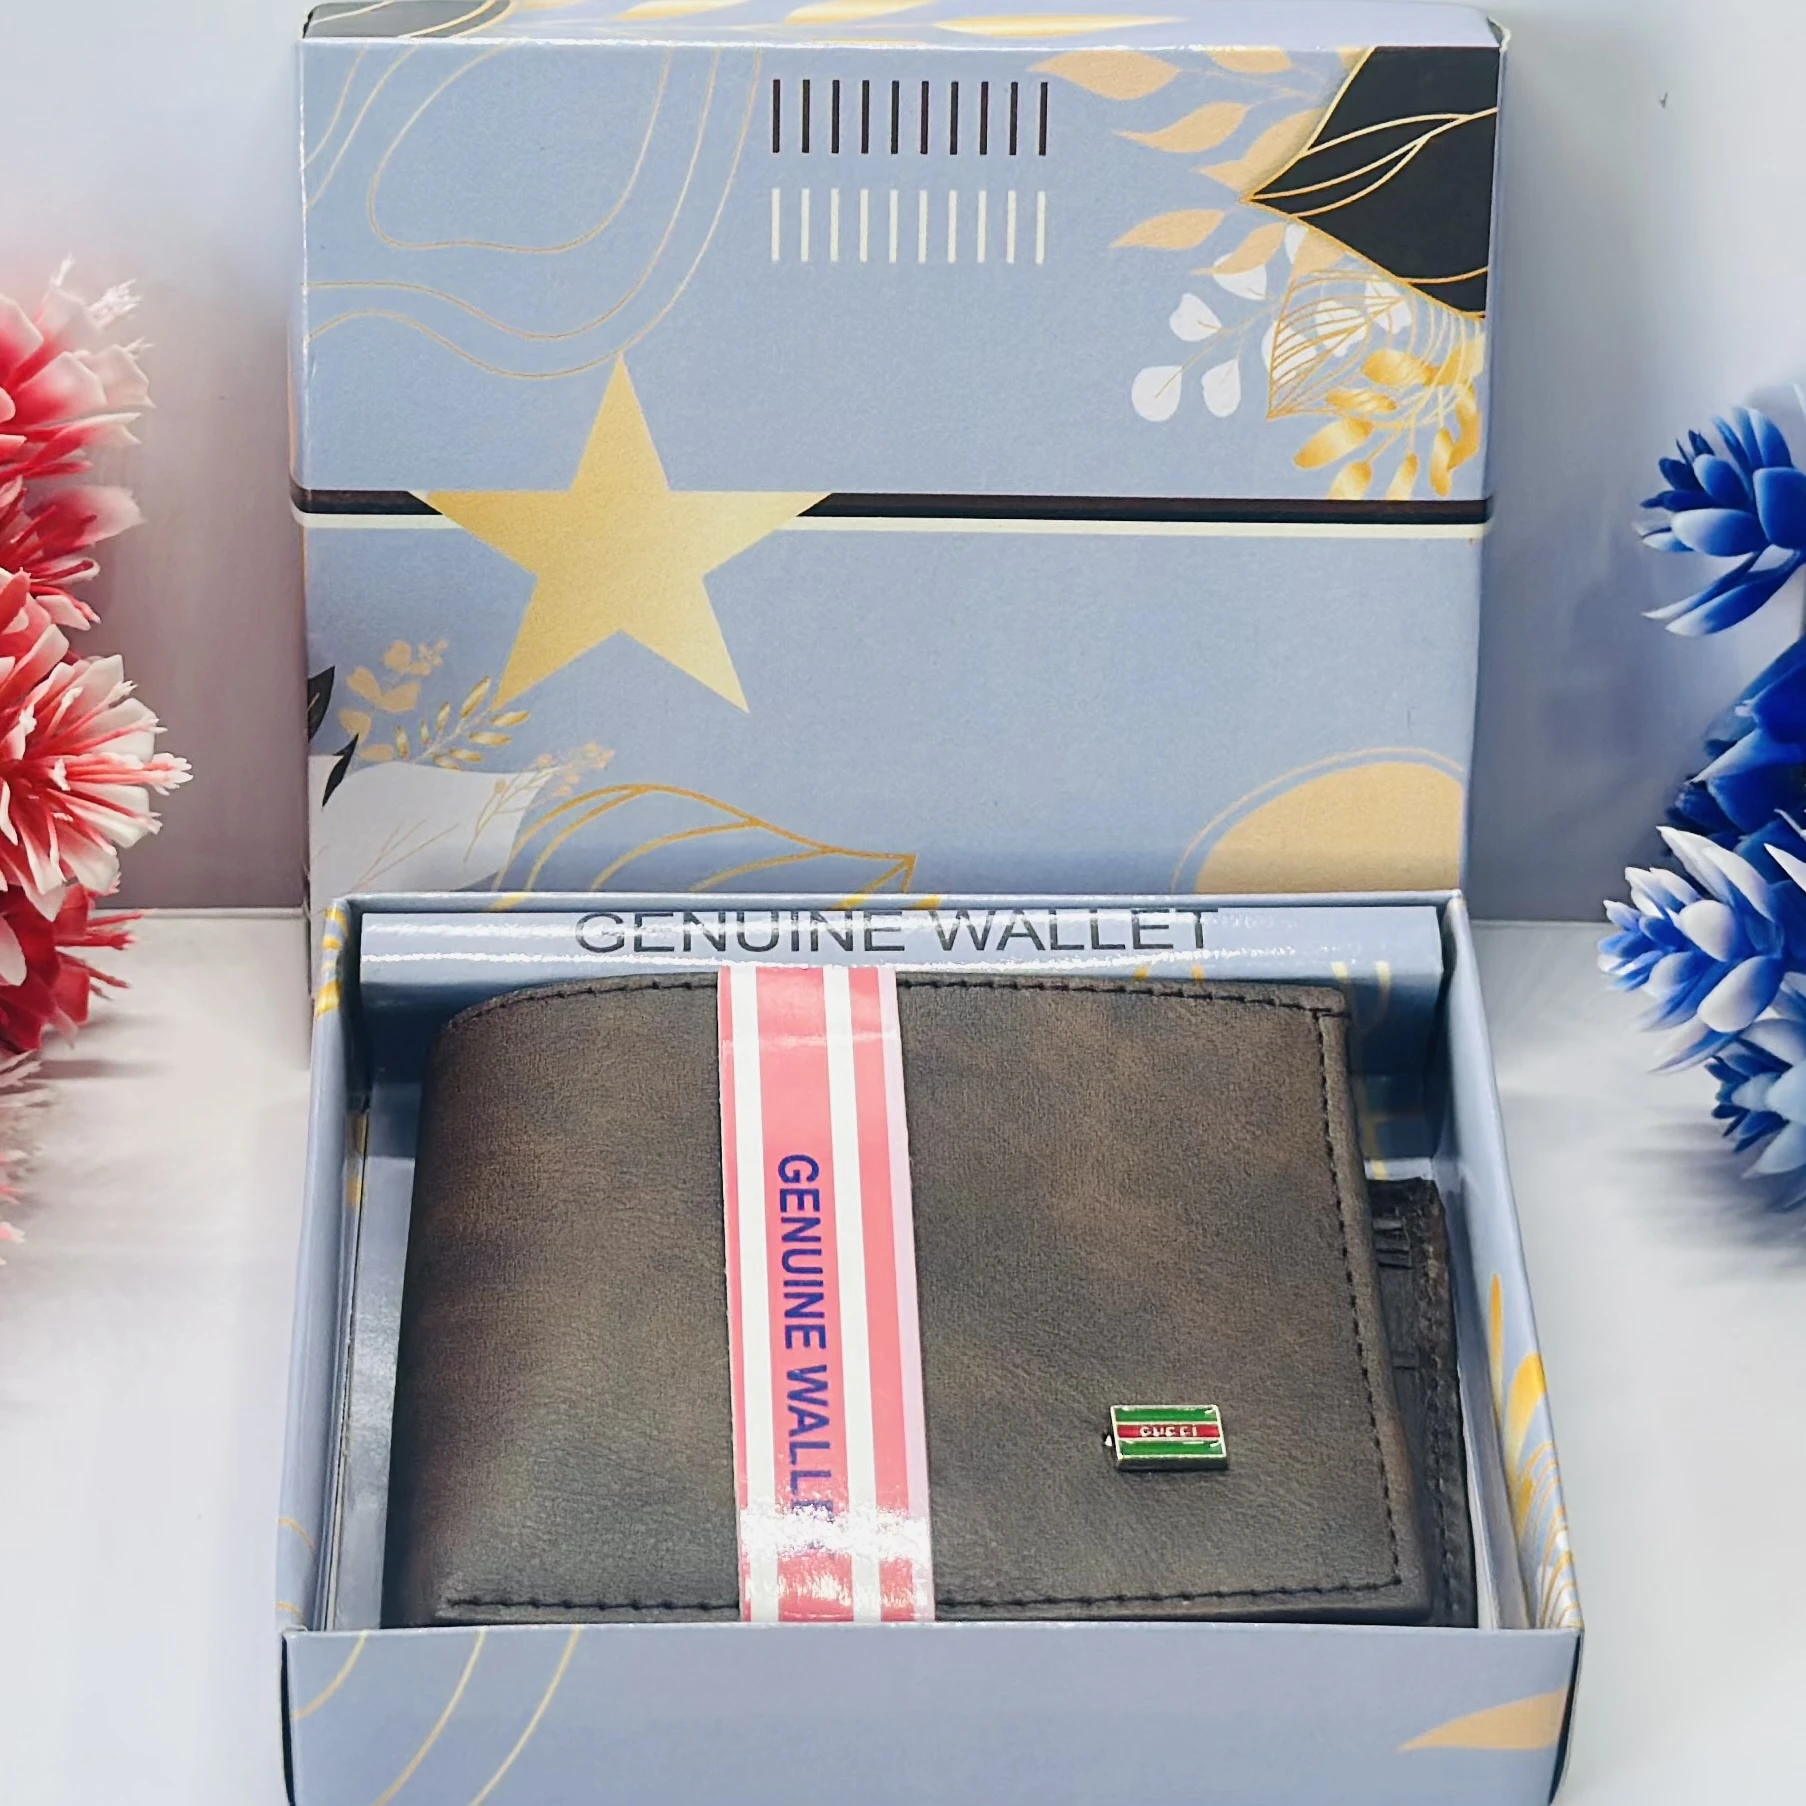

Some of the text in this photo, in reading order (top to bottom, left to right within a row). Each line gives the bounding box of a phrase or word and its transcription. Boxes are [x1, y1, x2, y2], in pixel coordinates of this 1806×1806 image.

[575, 907, 1218, 953] GENUINE WALLET
[777, 1153, 827, 1350] GENUINE
